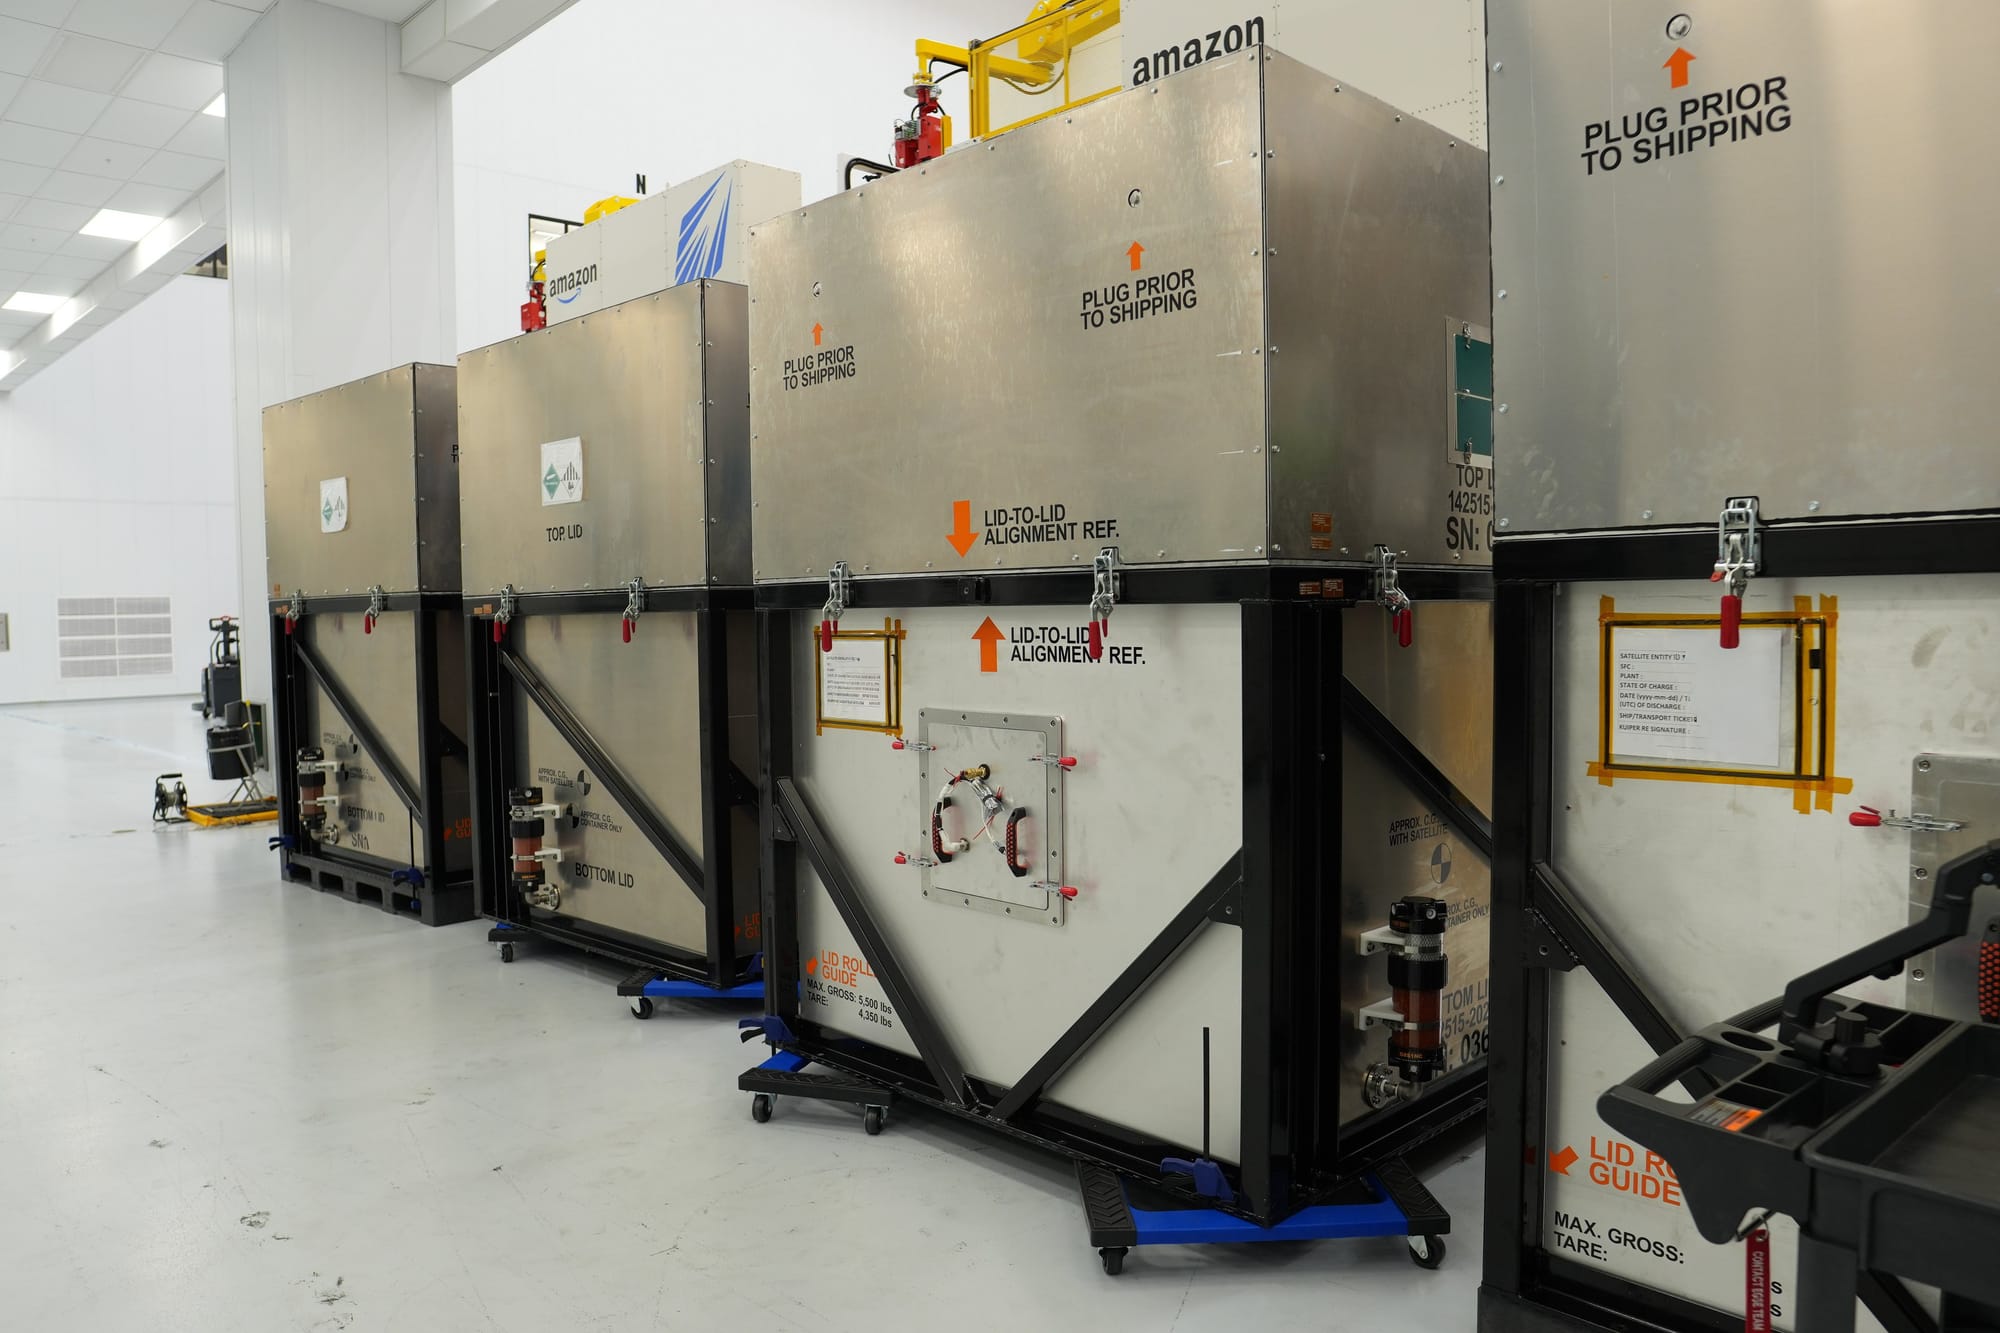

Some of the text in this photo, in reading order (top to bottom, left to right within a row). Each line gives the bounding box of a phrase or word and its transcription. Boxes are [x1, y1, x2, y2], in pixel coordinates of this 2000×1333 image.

[1132, 15, 1264, 86] amazon
[1584, 75, 1788, 149] PLUG PRIOR
[1580, 104, 1792, 175] TO SHIPPING
[549, 263, 598, 297] amazon
[1082, 268, 1195, 310] PLUG PRIOR
[1080, 289, 1197, 330] TO SHIPPING
[784, 345, 855, 375] PLUG PRIOR
[783, 361, 856, 391] TO SHIPPING
[1455, 464, 1484, 489] TOP
[984, 503, 1066, 527] LID-TO-LID
[546, 523, 583, 542] TOP LID
[984, 519, 1120, 545] ALIGNMENT REF.
[1446, 515, 1479, 551] SN:
[1010, 645, 1146, 665] ALIGNMEN REF.
[1619, 712, 1671, 721] SHIP/TRANSPORT
[1650, 726, 1687, 734] SIGNATURE
[580, 818, 623, 833] CONTAINER ONLY
[1389, 823, 1449, 847] WITH SATELLITE
[575, 862, 635, 889] BOTTOM LID
[821, 949, 877, 977] LID ROLL
[822, 964, 857, 988] GUIDE
[807, 978, 892, 1015] MAX. GROSS: 5,500 lbs
[1477, 978, 1488, 1000] LI
[807, 990, 892, 1029] TARE: 4,350 lbs
[1590, 1135, 1635, 1167] LID
[1589, 1161, 1682, 1207] GUIDE
[1553, 1230, 1608, 1262] TARE:
[1554, 1210, 1684, 1265] MAX. GROSS:
[1751, 1250, 1764, 1288] CONTACT
[1751, 1309, 1765, 1332] TEAM
